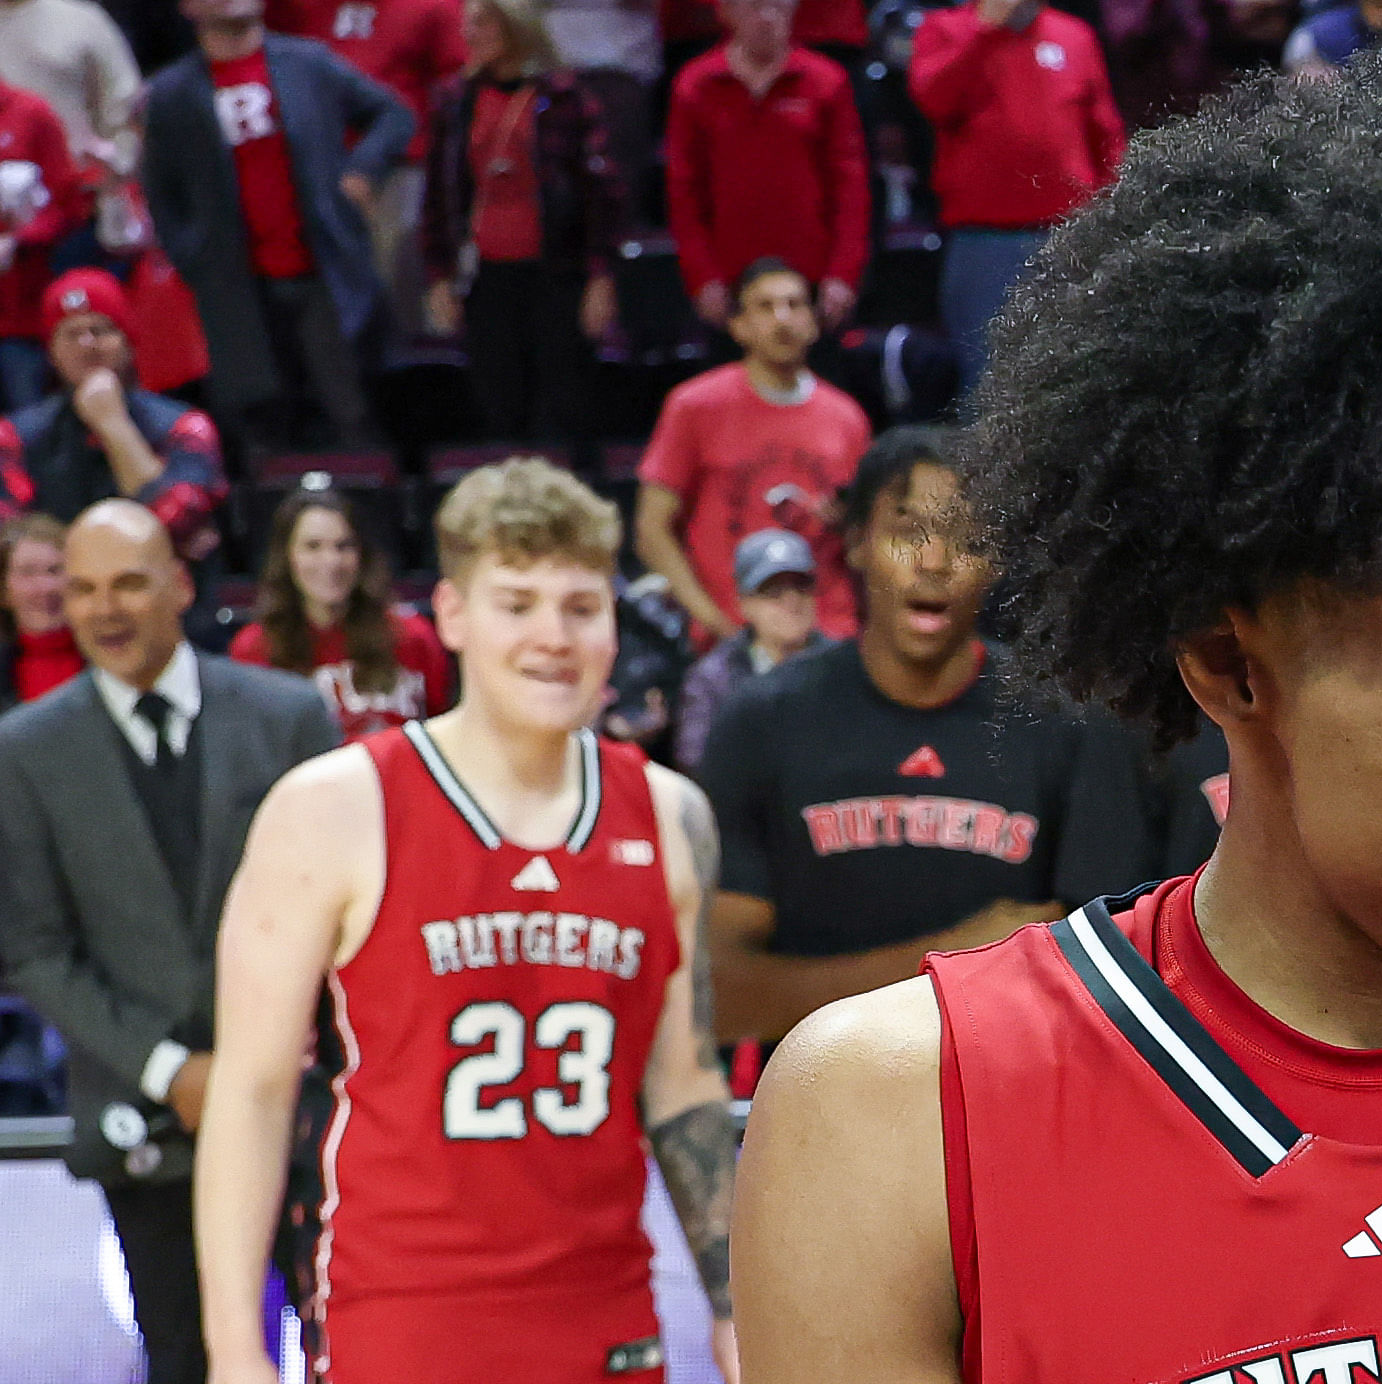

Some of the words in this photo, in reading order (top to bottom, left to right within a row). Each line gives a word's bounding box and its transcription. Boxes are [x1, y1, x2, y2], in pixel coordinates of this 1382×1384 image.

[213, 82, 275, 146] R
[802, 795, 1040, 865] RUTGERS
[421, 911, 645, 980] RUTGERS
[442, 1000, 618, 1141] 23
